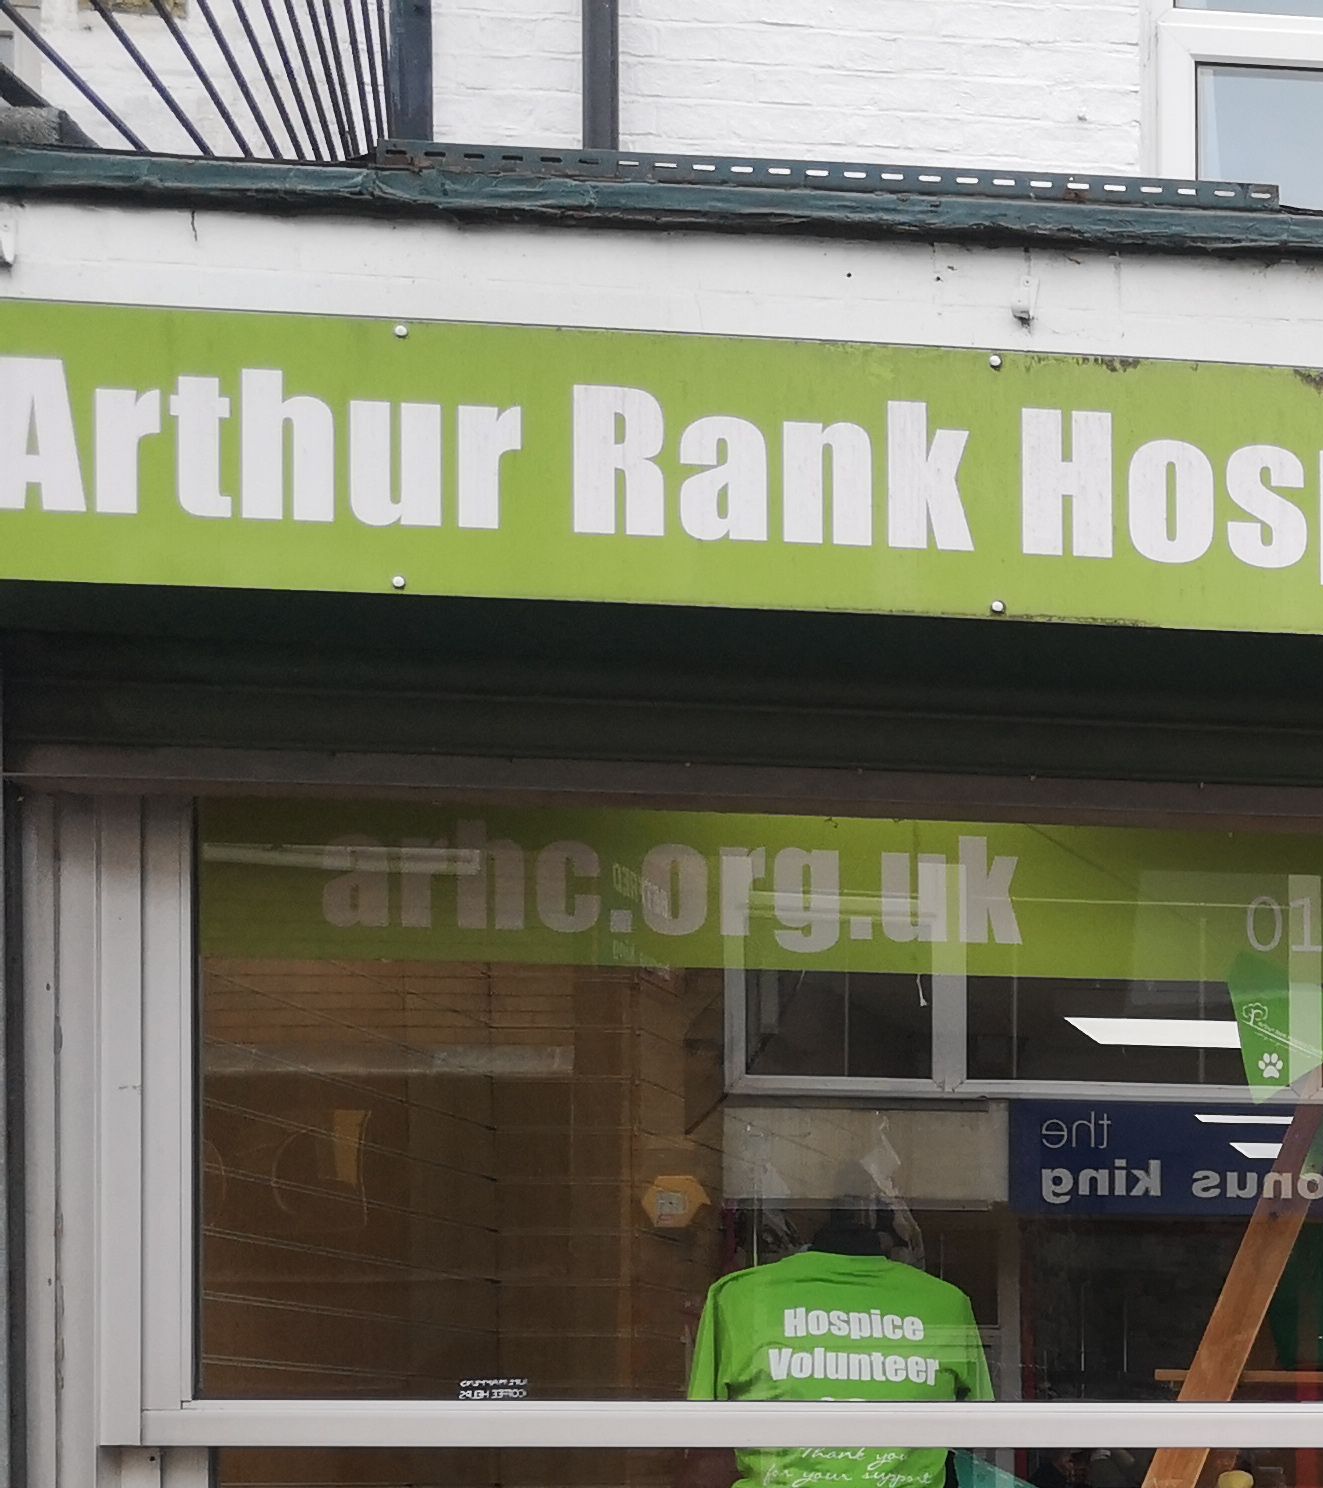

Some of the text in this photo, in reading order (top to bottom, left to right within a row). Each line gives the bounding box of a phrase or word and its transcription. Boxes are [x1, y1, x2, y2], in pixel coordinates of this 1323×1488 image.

[0, 355, 522, 529] Arthur
[573, 384, 974, 551] Rank
[322, 819, 1023, 952] arhc.org.uk
[769, 1347, 940, 1386] Volunteer
[784, 1307, 924, 1341] Hospice
